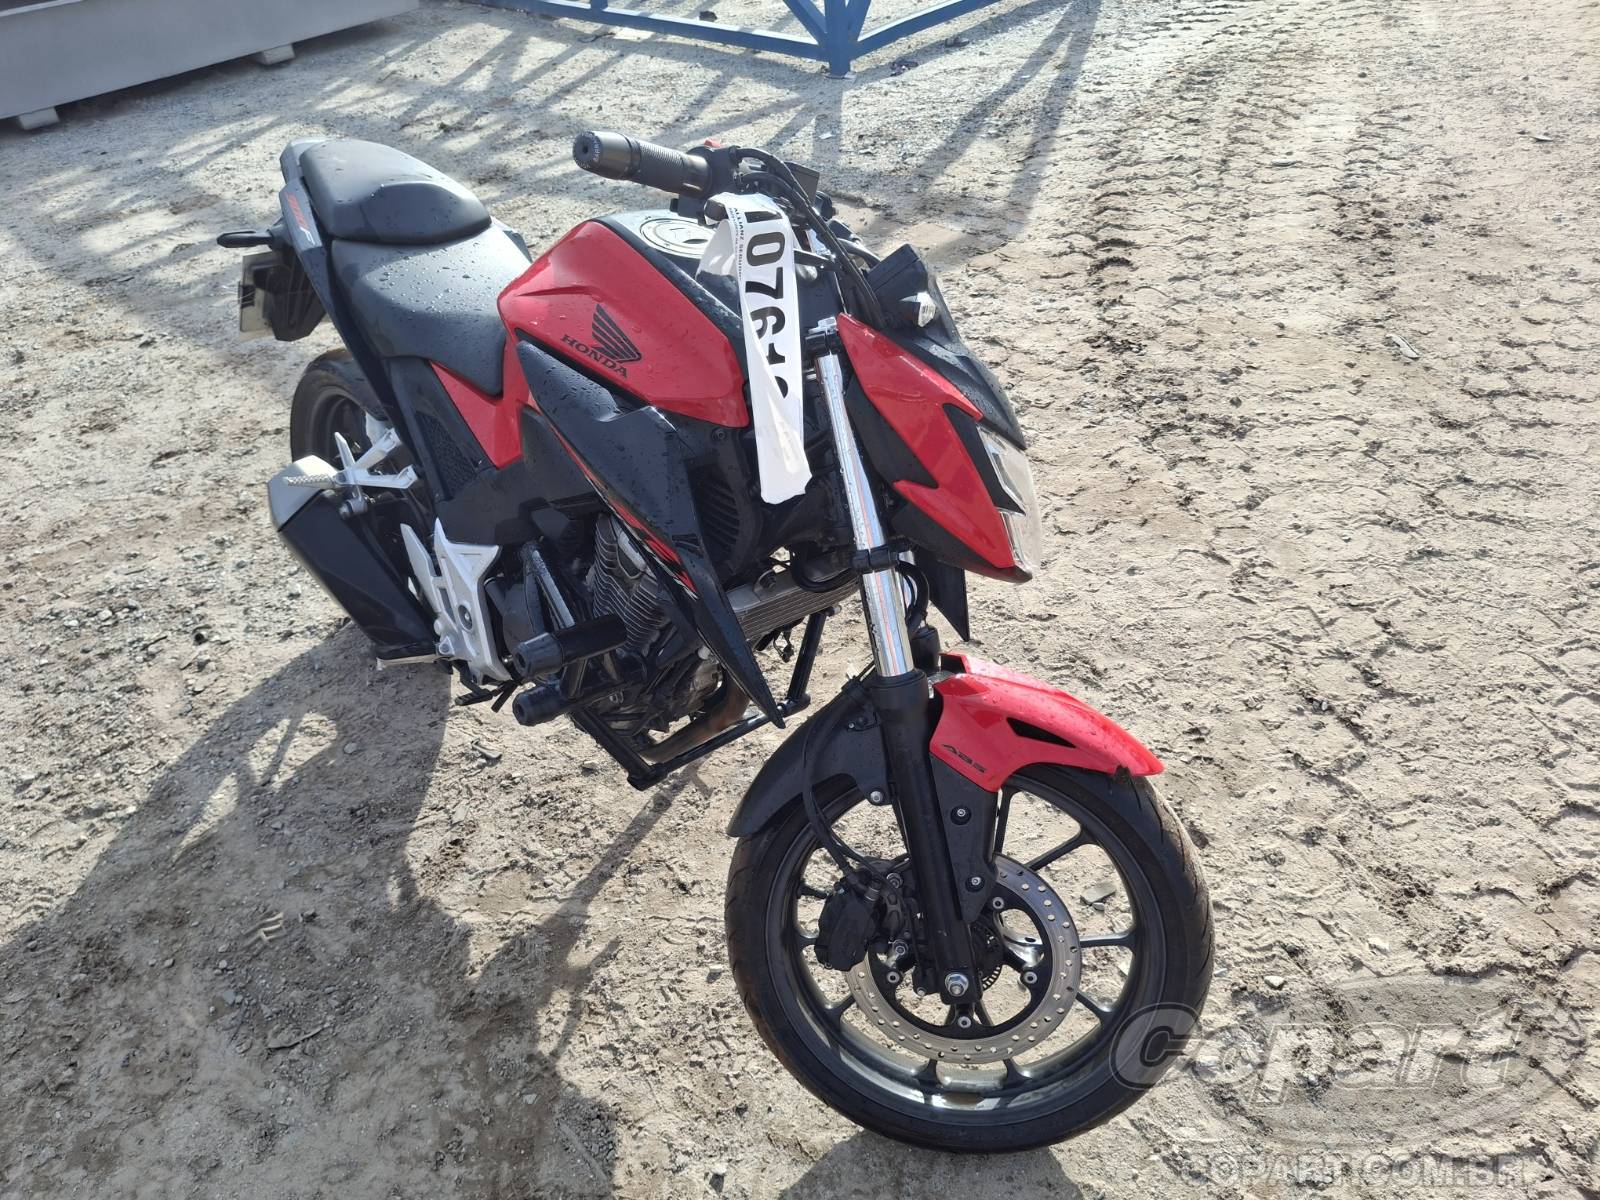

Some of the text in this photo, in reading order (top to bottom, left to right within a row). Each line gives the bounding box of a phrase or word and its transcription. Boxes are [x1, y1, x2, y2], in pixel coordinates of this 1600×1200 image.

[733, 207, 745, 241] ALLIANZ
[745, 210, 789, 398] 10761
[560, 333, 628, 378] HONDA
[941, 743, 987, 773] ABS
